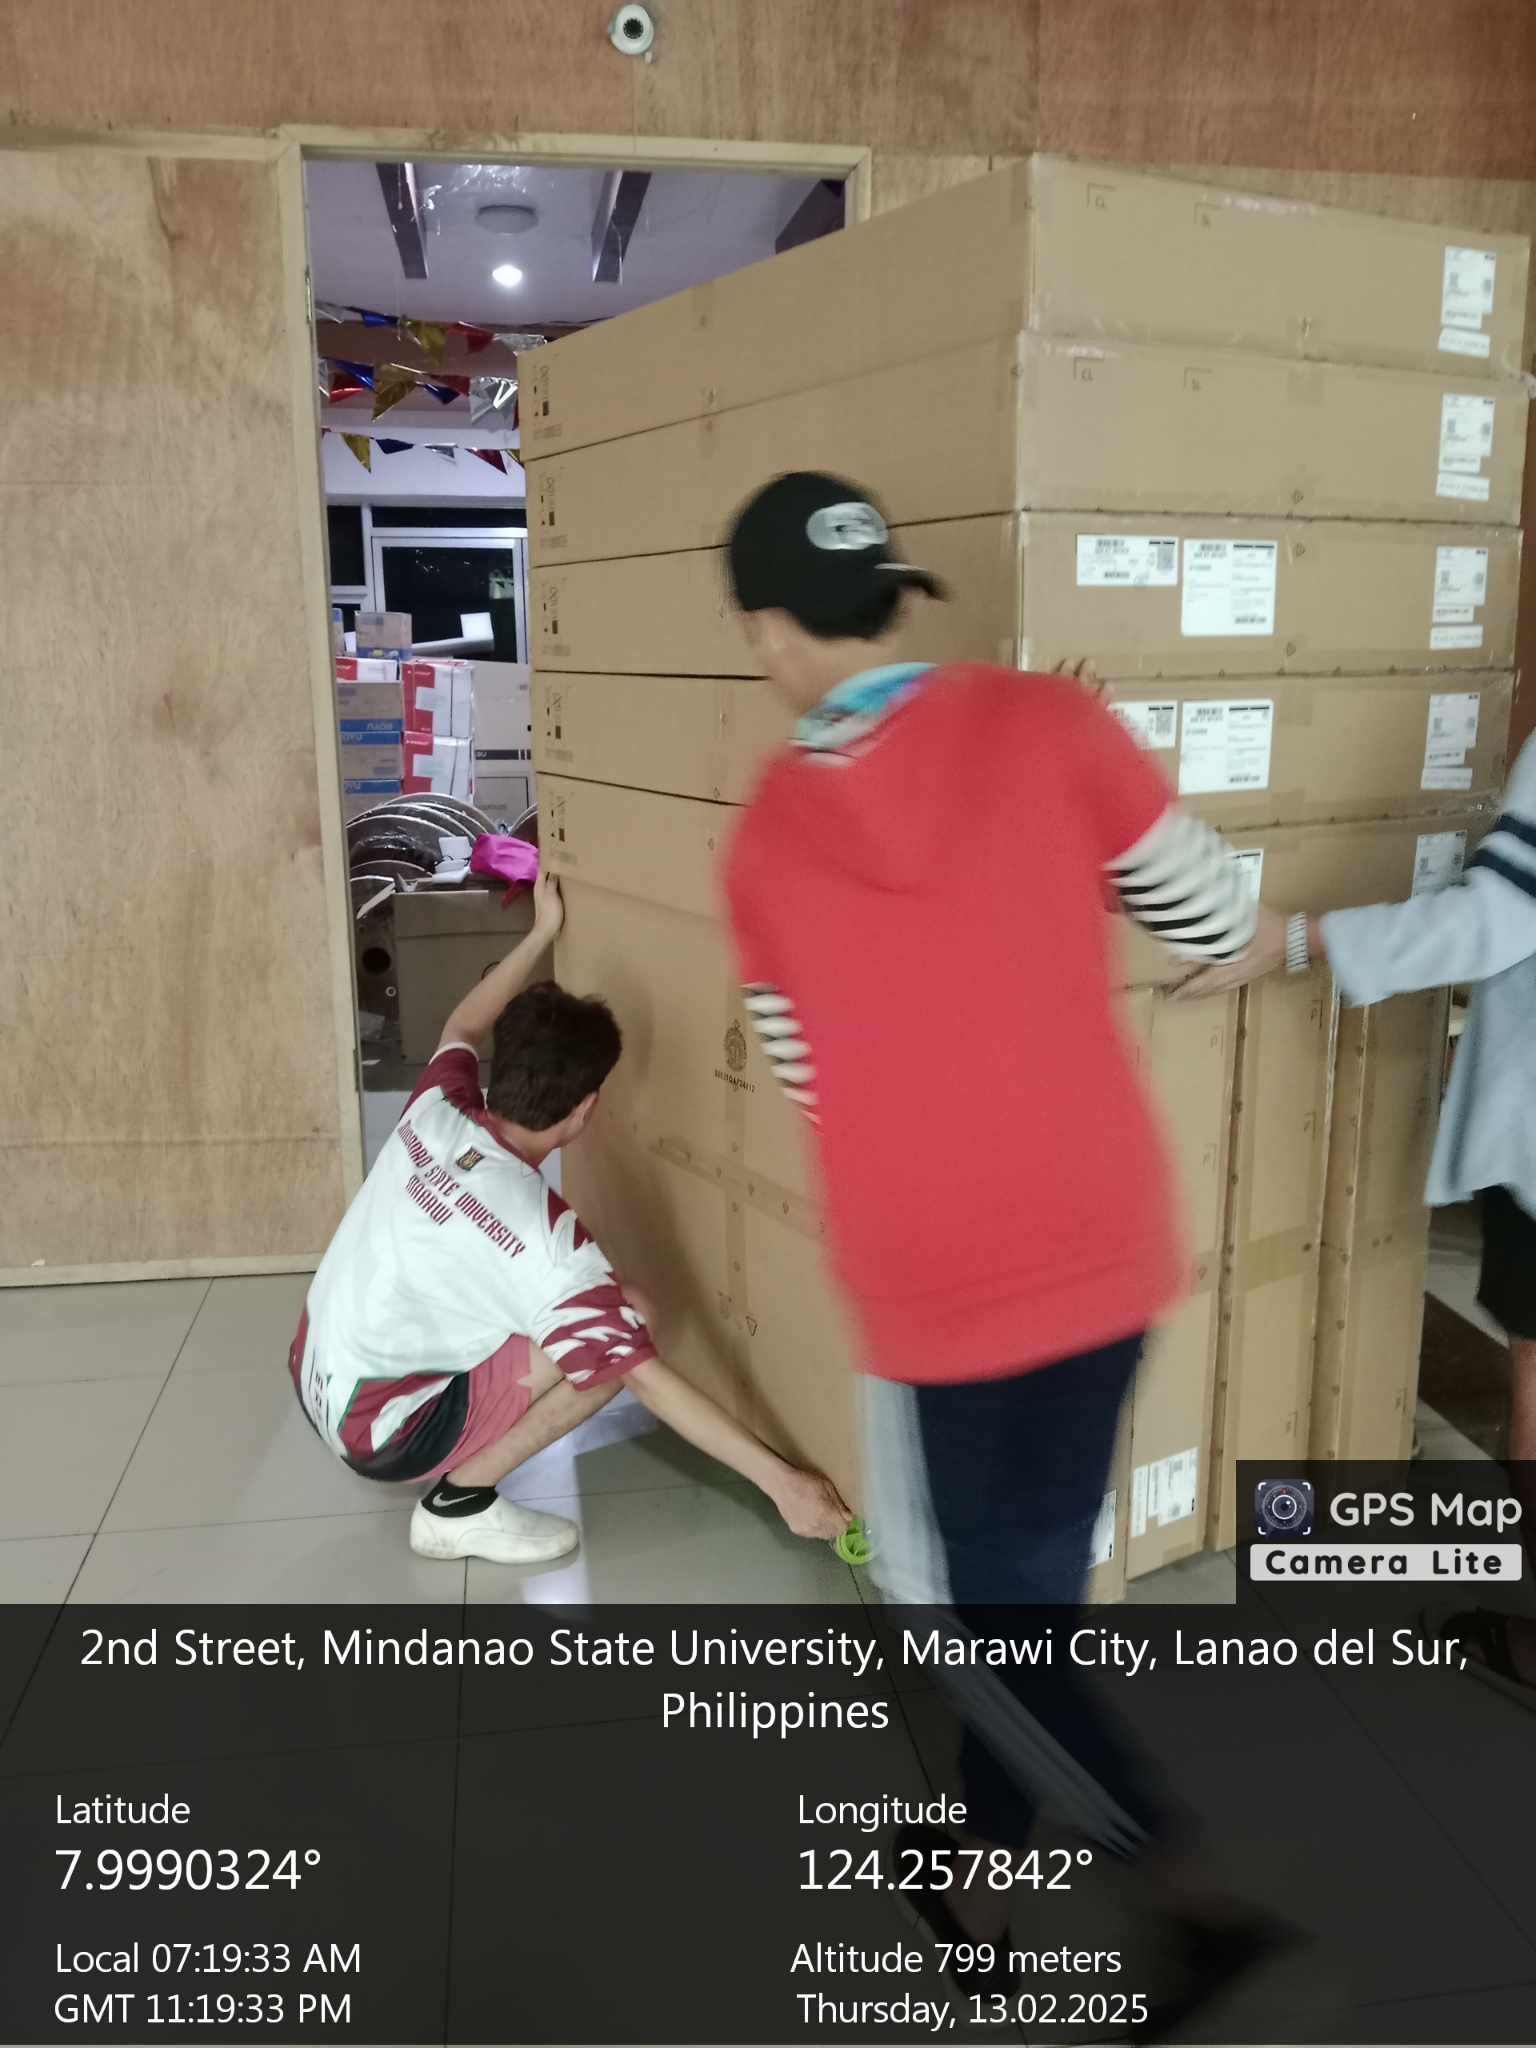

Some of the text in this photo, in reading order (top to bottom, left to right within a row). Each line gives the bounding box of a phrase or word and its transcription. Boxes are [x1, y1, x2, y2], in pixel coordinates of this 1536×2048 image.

[405, 1173, 454, 1227] MARAWI
[423, 1164, 461, 1198] STATE
[453, 1191, 526, 1259] UNIVERSITY
